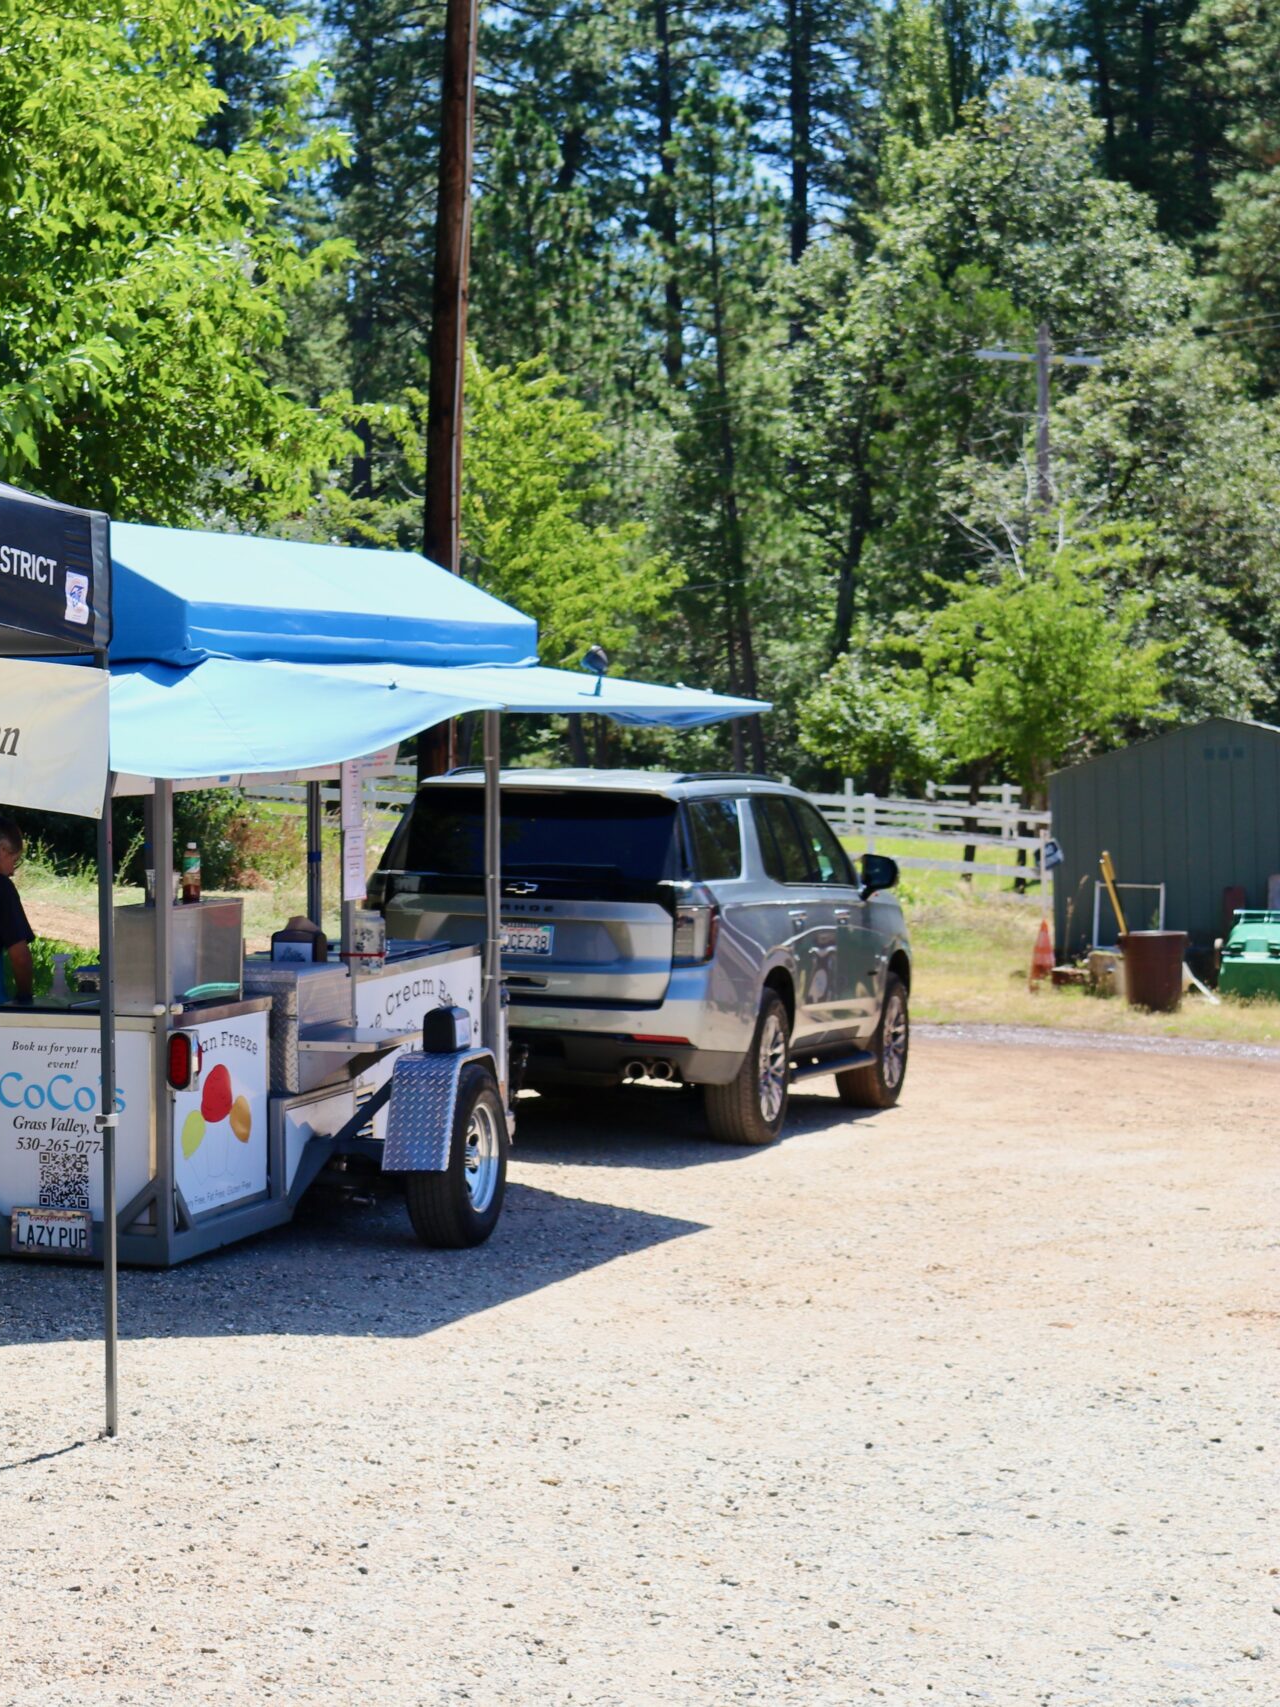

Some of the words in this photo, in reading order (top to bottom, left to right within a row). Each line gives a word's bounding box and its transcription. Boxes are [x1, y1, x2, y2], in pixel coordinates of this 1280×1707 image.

[500, 903, 554, 913] AHOE
[385, 979, 435, 1015] Cream
[12, 1040, 35, 1051] Book
[37, 1044, 48, 1052] us
[48, 1042, 64, 1055] for
[66, 1045, 89, 1056] your
[90, 1046, 102, 1054] ne
[221, 1031, 258, 1055] Freeze
[47, 1059, 79, 1069] event!
[13, 1115, 48, 1131] Grass
[50, 1117, 90, 1138] Valley,
[16, 1136, 104, 1154] 530-265-077
[17, 1223, 55, 1249] LAZY
[59, 1226, 87, 1249] PUP
